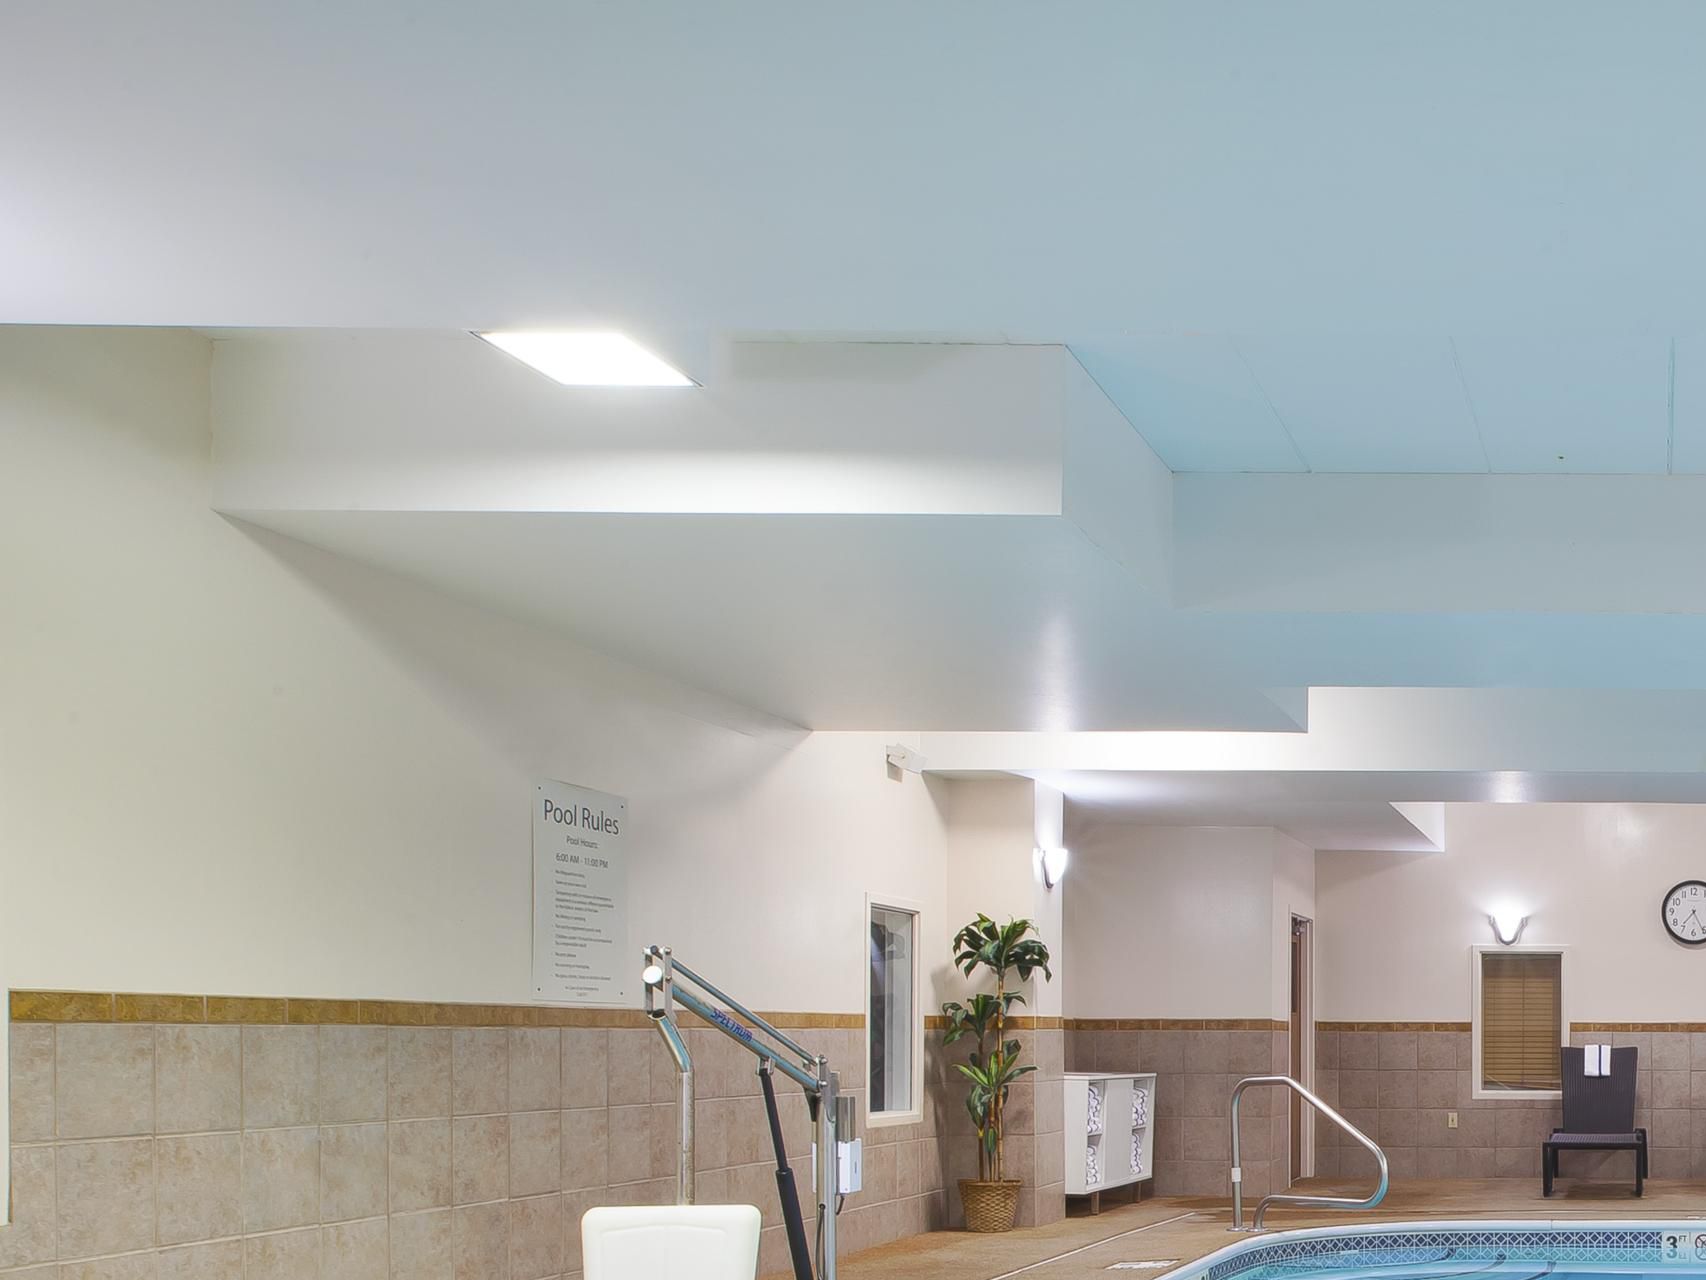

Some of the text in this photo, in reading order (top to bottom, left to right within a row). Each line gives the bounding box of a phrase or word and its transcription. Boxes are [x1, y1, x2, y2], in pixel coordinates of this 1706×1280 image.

[544, 799, 619, 835] Pool Rules
[566, 835, 580, 846] Pool
[570, 855, 580, 865] AM
[600, 860, 609, 869] PM
[1681, 890, 1687, 899] 11
[1690, 887, 1698, 896] 12
[1703, 890, 1706, 898] 1
[1672, 897, 1681, 906] 10
[1669, 907, 1675, 916] 9
[1672, 918, 1678, 927] 8
[1680, 924, 1686, 935] 7
[1690, 928, 1697, 937] 6
